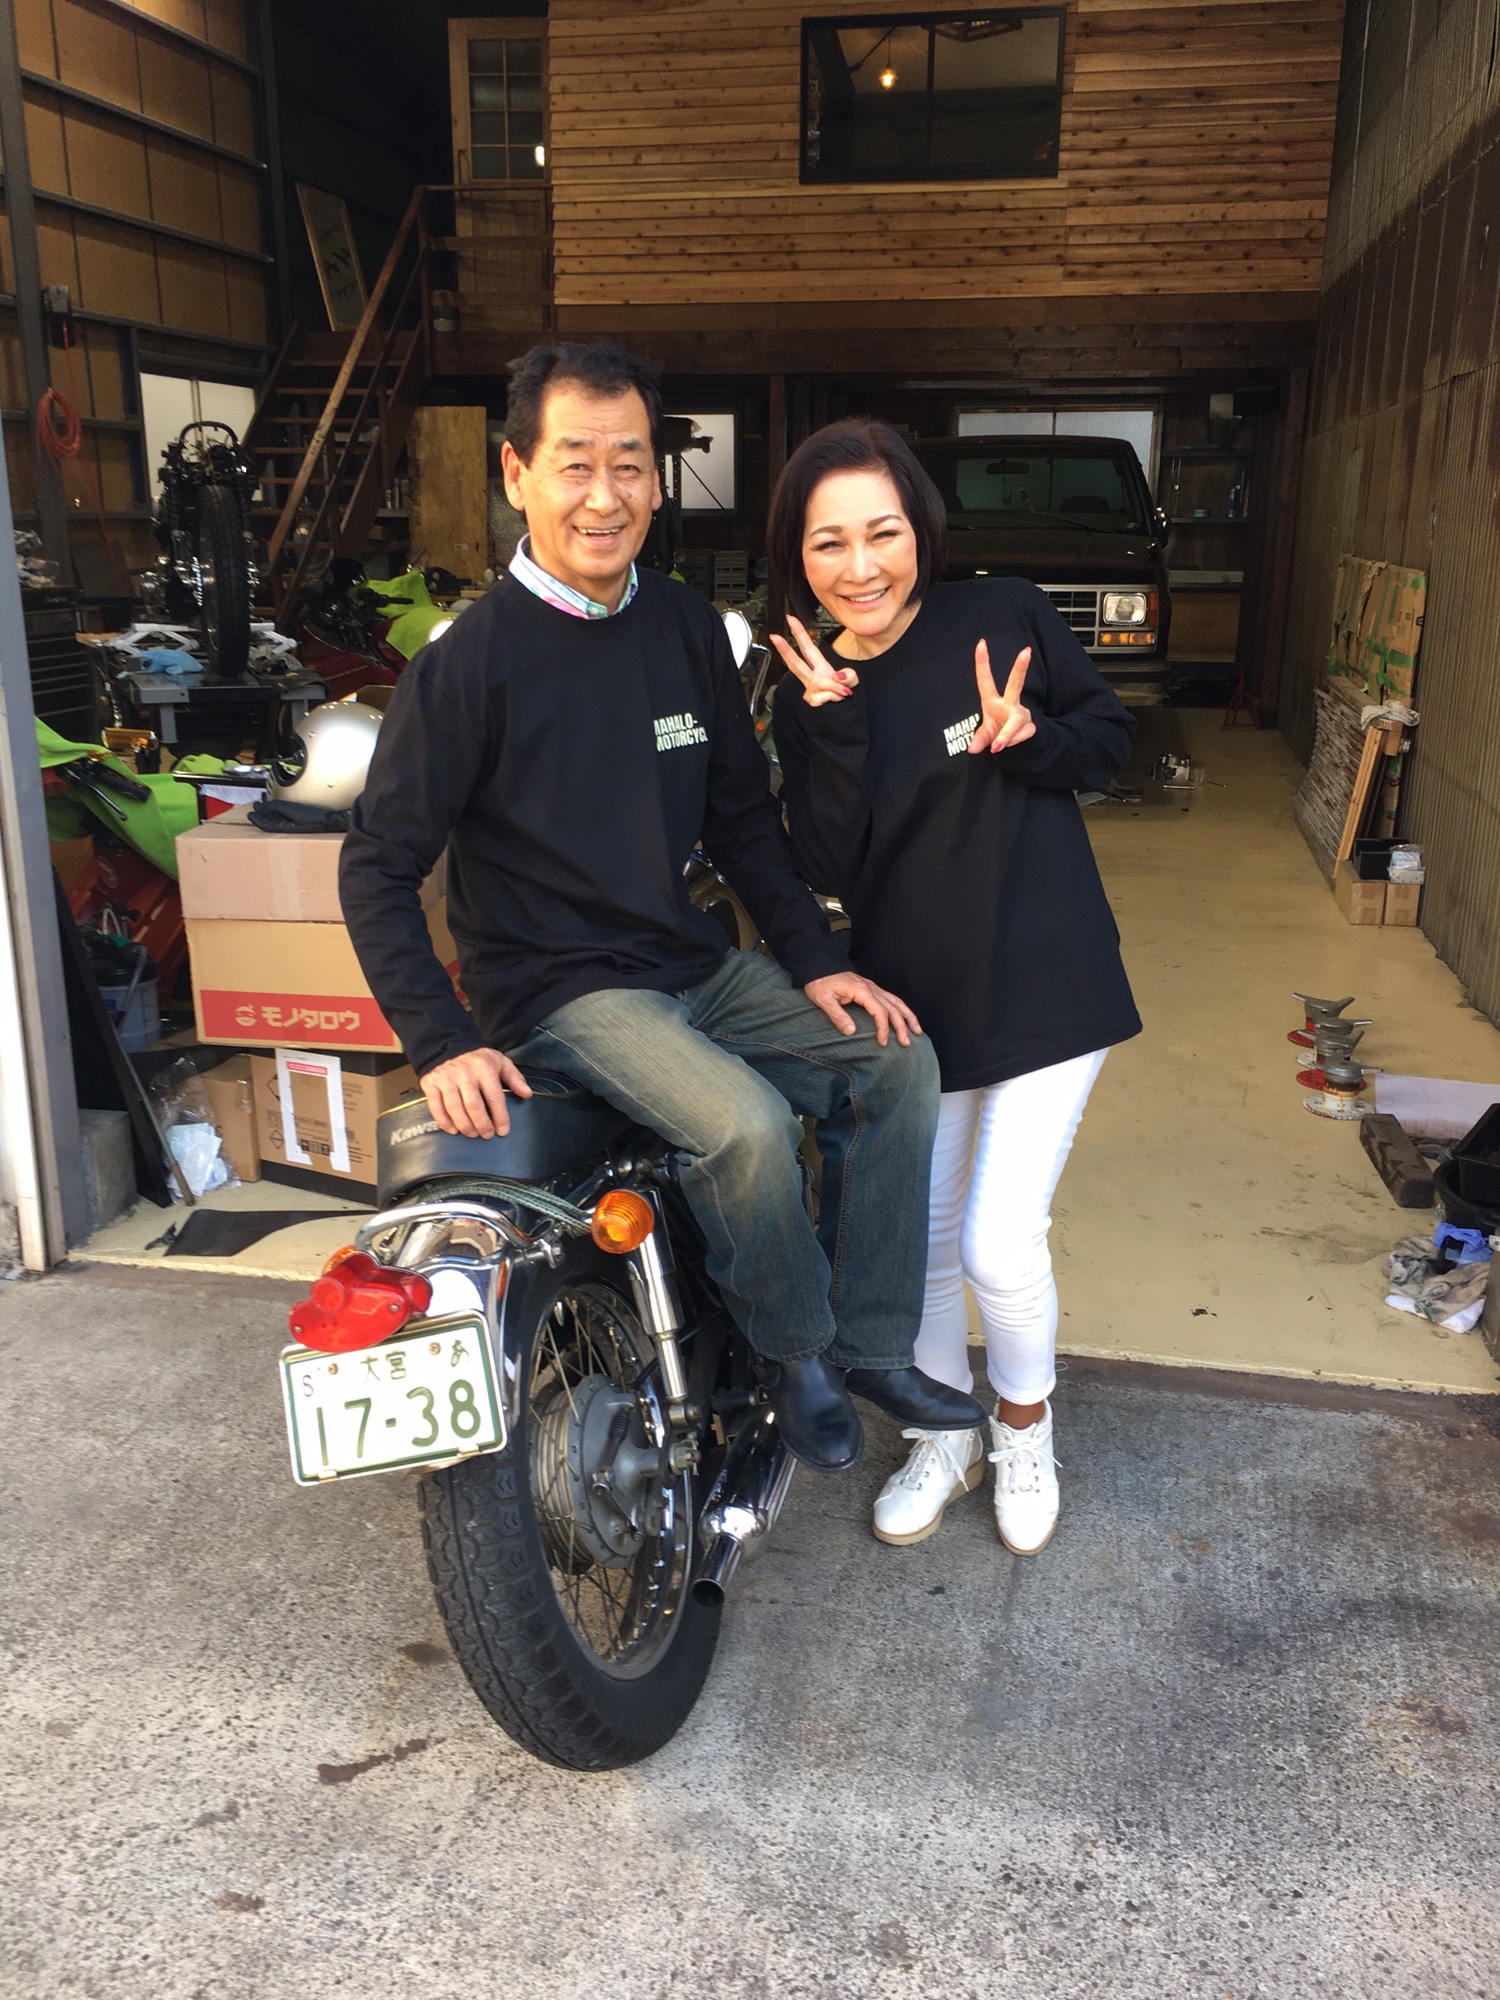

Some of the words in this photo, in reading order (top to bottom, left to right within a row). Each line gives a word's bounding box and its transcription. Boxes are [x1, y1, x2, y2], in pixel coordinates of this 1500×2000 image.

[261, 1006, 361, 1031] モノタロウ
[302, 1374, 314, 1397] S
[359, 1350, 407, 1384] 大宮
[316, 1379, 481, 1466] 17-38
